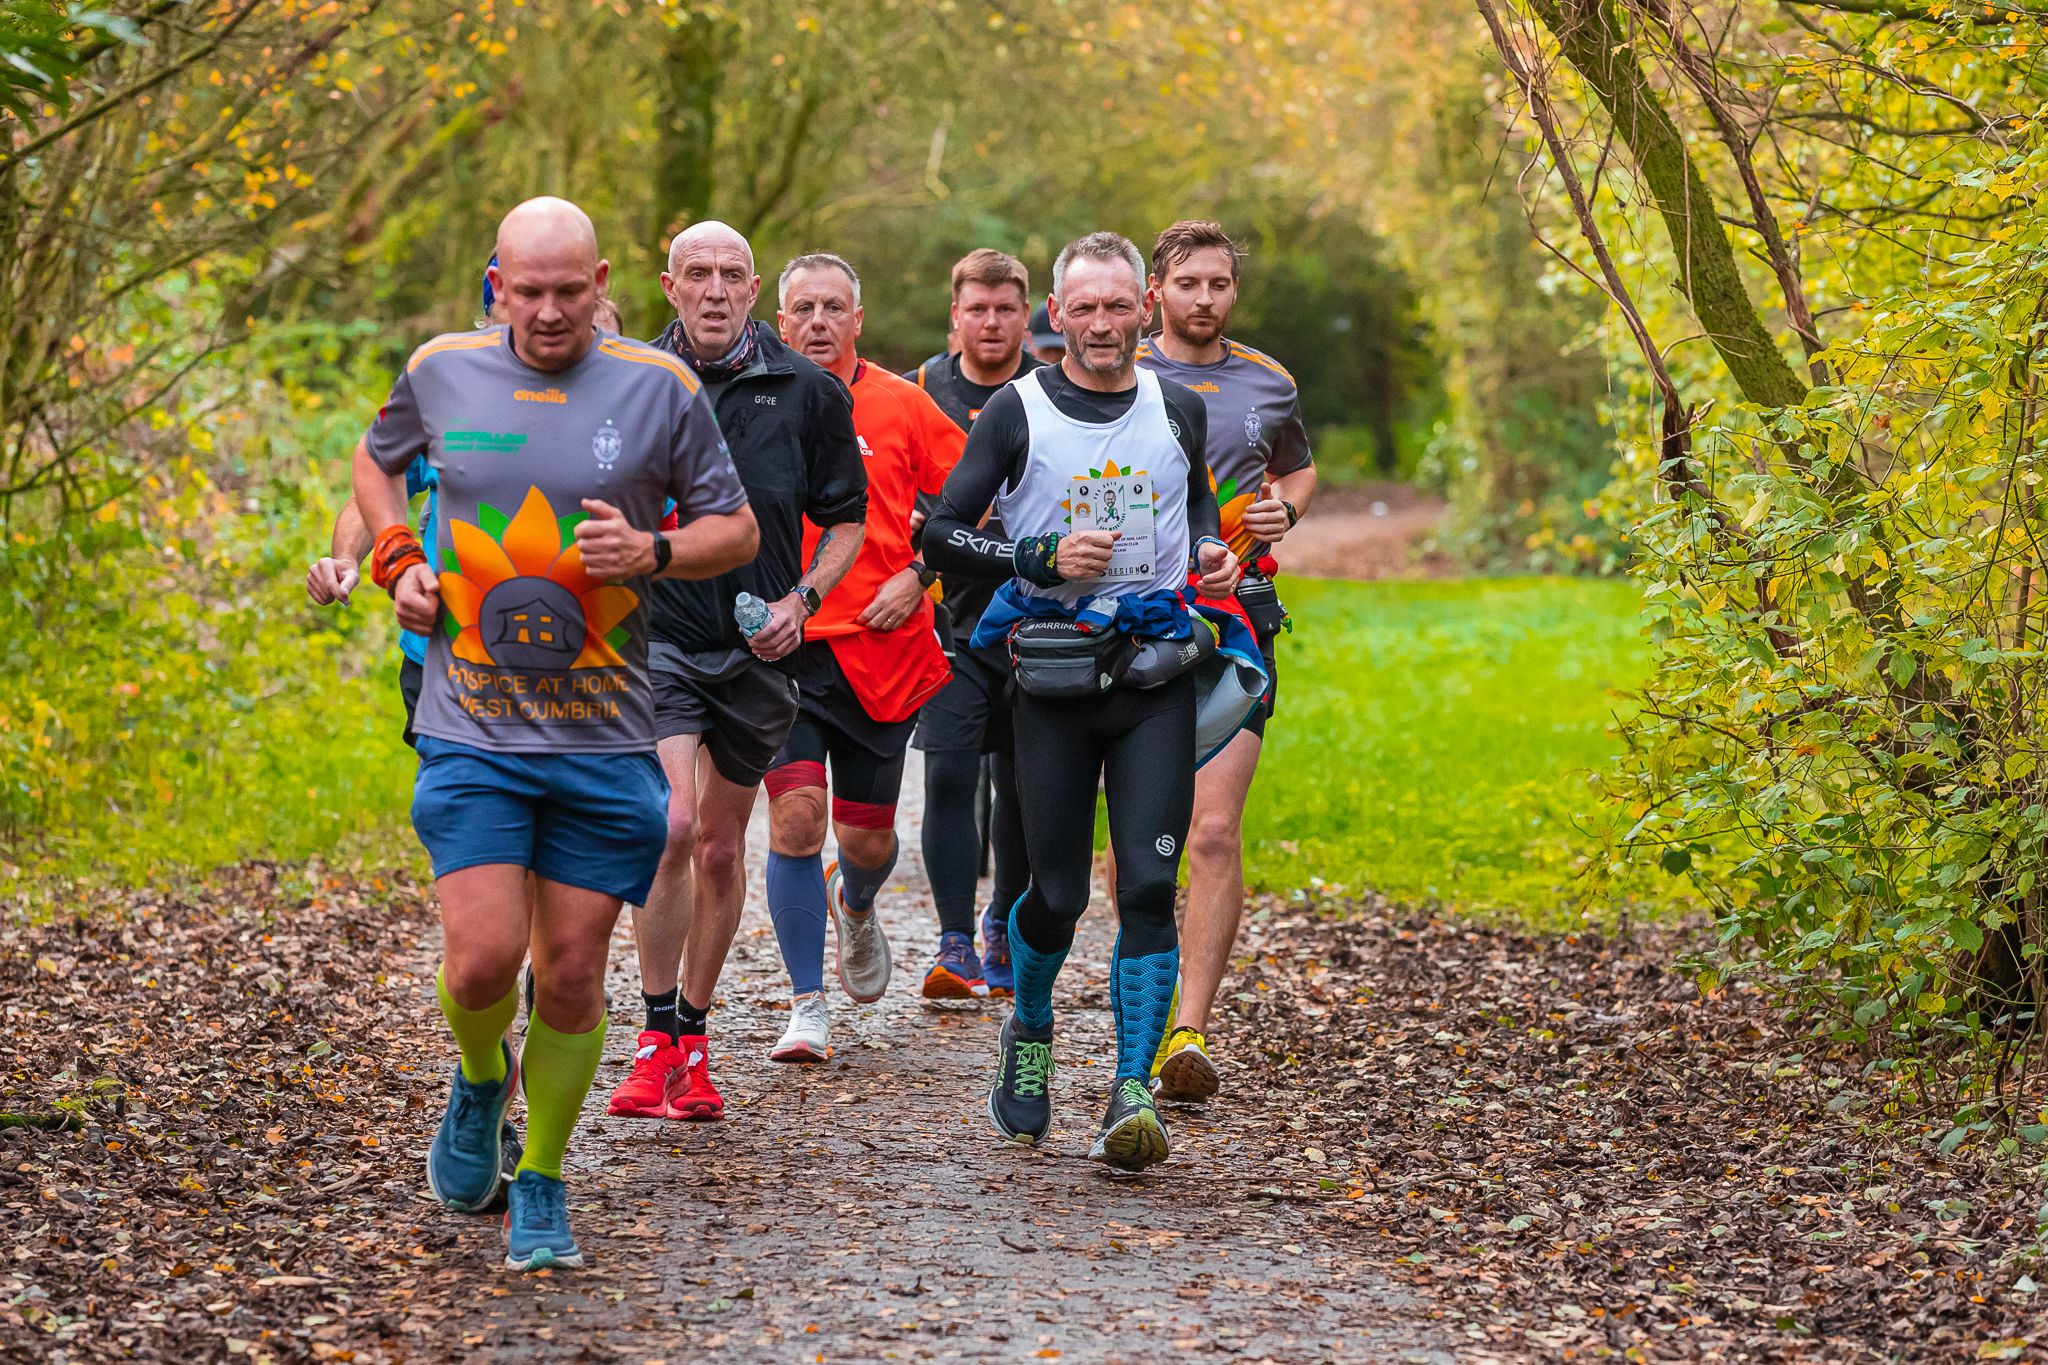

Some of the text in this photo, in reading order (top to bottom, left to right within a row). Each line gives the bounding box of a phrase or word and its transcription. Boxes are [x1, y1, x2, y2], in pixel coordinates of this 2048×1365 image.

[754, 395, 777, 406] GORE
[1108, 566, 1140, 575] DESIGN
[1034, 621, 1083, 632] KARRIMO
[447, 663, 631, 695] HOSPICE AT HOME
[519, 701, 622, 721] CUMBRIA
